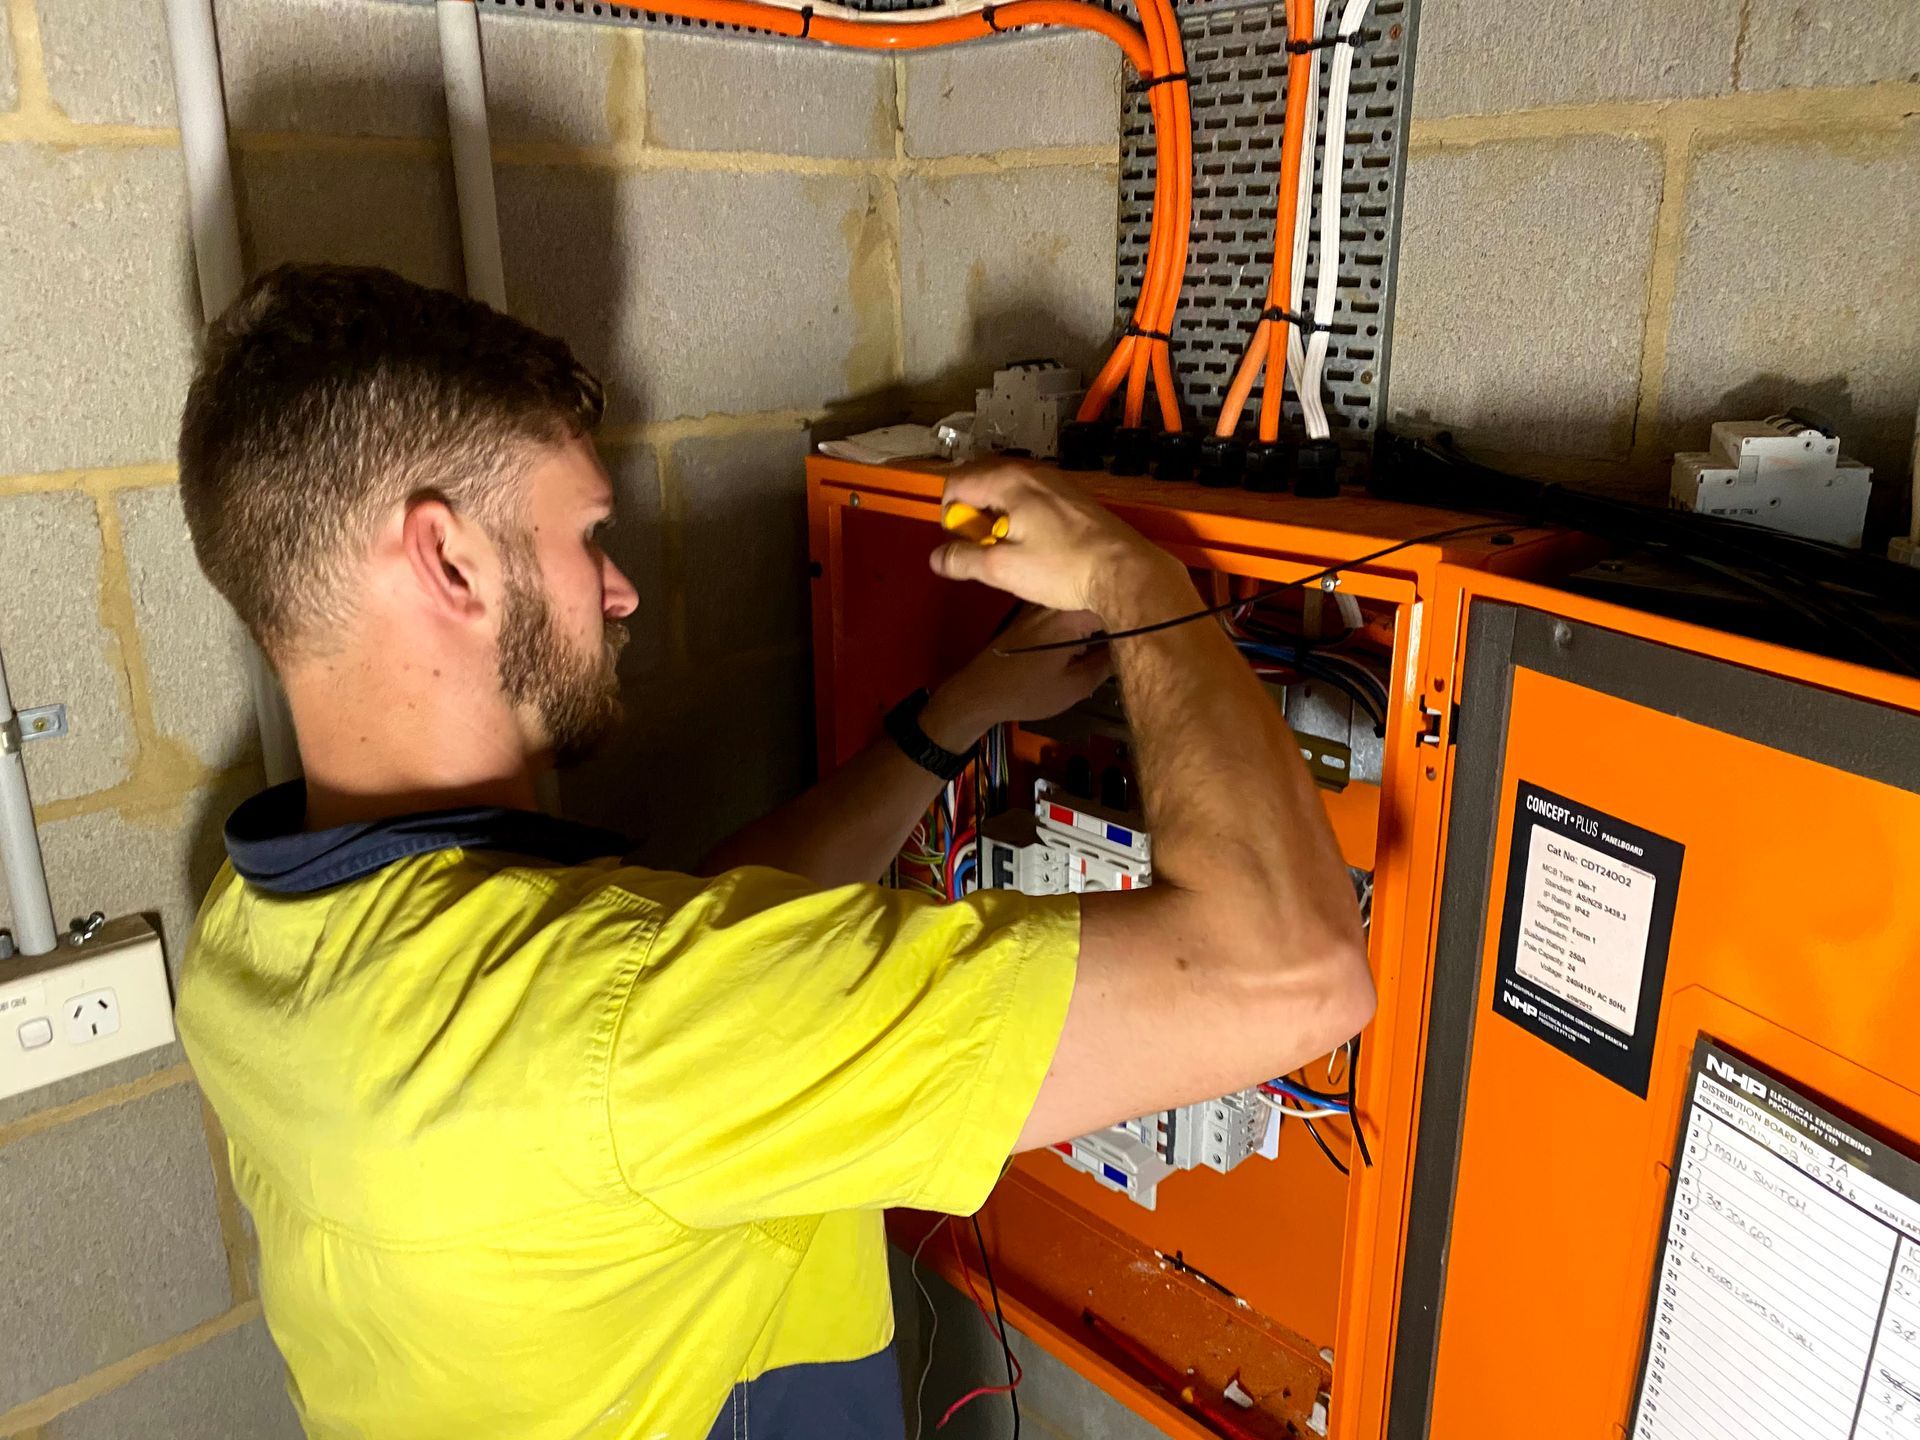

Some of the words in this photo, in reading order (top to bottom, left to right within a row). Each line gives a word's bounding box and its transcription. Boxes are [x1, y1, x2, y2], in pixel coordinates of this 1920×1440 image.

[1526, 794, 1570, 825] CONCEPT
[1576, 814, 1599, 838] PLUS
[1601, 832, 1644, 856] PANELBOARD
[1546, 843, 1562, 856] Cat
[1564, 850, 1578, 864] No:
[1542, 863, 1558, 876] MCB
[1578, 880, 1596, 893] Din-T
[1537, 900, 1572, 922] Segregation
[1574, 905, 1590, 918] IP42
[1572, 926, 1591, 941] Form
[1504, 990, 1538, 1018] NHP
[1597, 993, 1607, 1002] AC
[1609, 998, 1626, 1014] 50Hz
[1538, 1016, 1560, 1033] PRODUCTS
[1568, 1032, 1576, 1042] LTD
[1706, 1053, 1768, 1099] NHP
[1700, 1093, 1712, 1106] FED
[1713, 1101, 1734, 1121] FROM
[1702, 1080, 1762, 1122] DISTRIBUTION
[1764, 1117, 1797, 1144] BOARD
[1696, 1114, 1702, 1122] 1
[1768, 1099, 1808, 1128] PRODUCTS
[1809, 1123, 1823, 1137] PTY
[1824, 1133, 1839, 1147] LTD
[1770, 1089, 1815, 1122] ELECTRICAL
[1815, 1116, 1872, 1156] ENGINEERING
[1692, 1130, 1699, 1138] 3
[1690, 1145, 1696, 1154] 5
[1687, 1160, 1693, 1169] 7
[1714, 1143, 1748, 1171] MAIN
[1753, 1169, 1807, 1211] SWITCH
[1681, 1193, 1692, 1205] 11
[1678, 1208, 1690, 1221] 13
[1874, 1204, 1899, 1222] MAIN
[1676, 1224, 1687, 1236] 15
[1673, 1239, 1684, 1250] 17
[1670, 1254, 1681, 1266] 19
[1667, 1269, 1678, 1281] 21
[1665, 1284, 1676, 1296] 23
[1663, 1299, 1674, 1311] 25
[1661, 1313, 1672, 1325] 27
[1659, 1328, 1670, 1340] 29
[1657, 1342, 1667, 1354] 31
[1654, 1356, 1665, 1369] 33
[1651, 1370, 1662, 1384] 35
[1648, 1384, 1660, 1397] 37
[1646, 1399, 1657, 1412] 39
